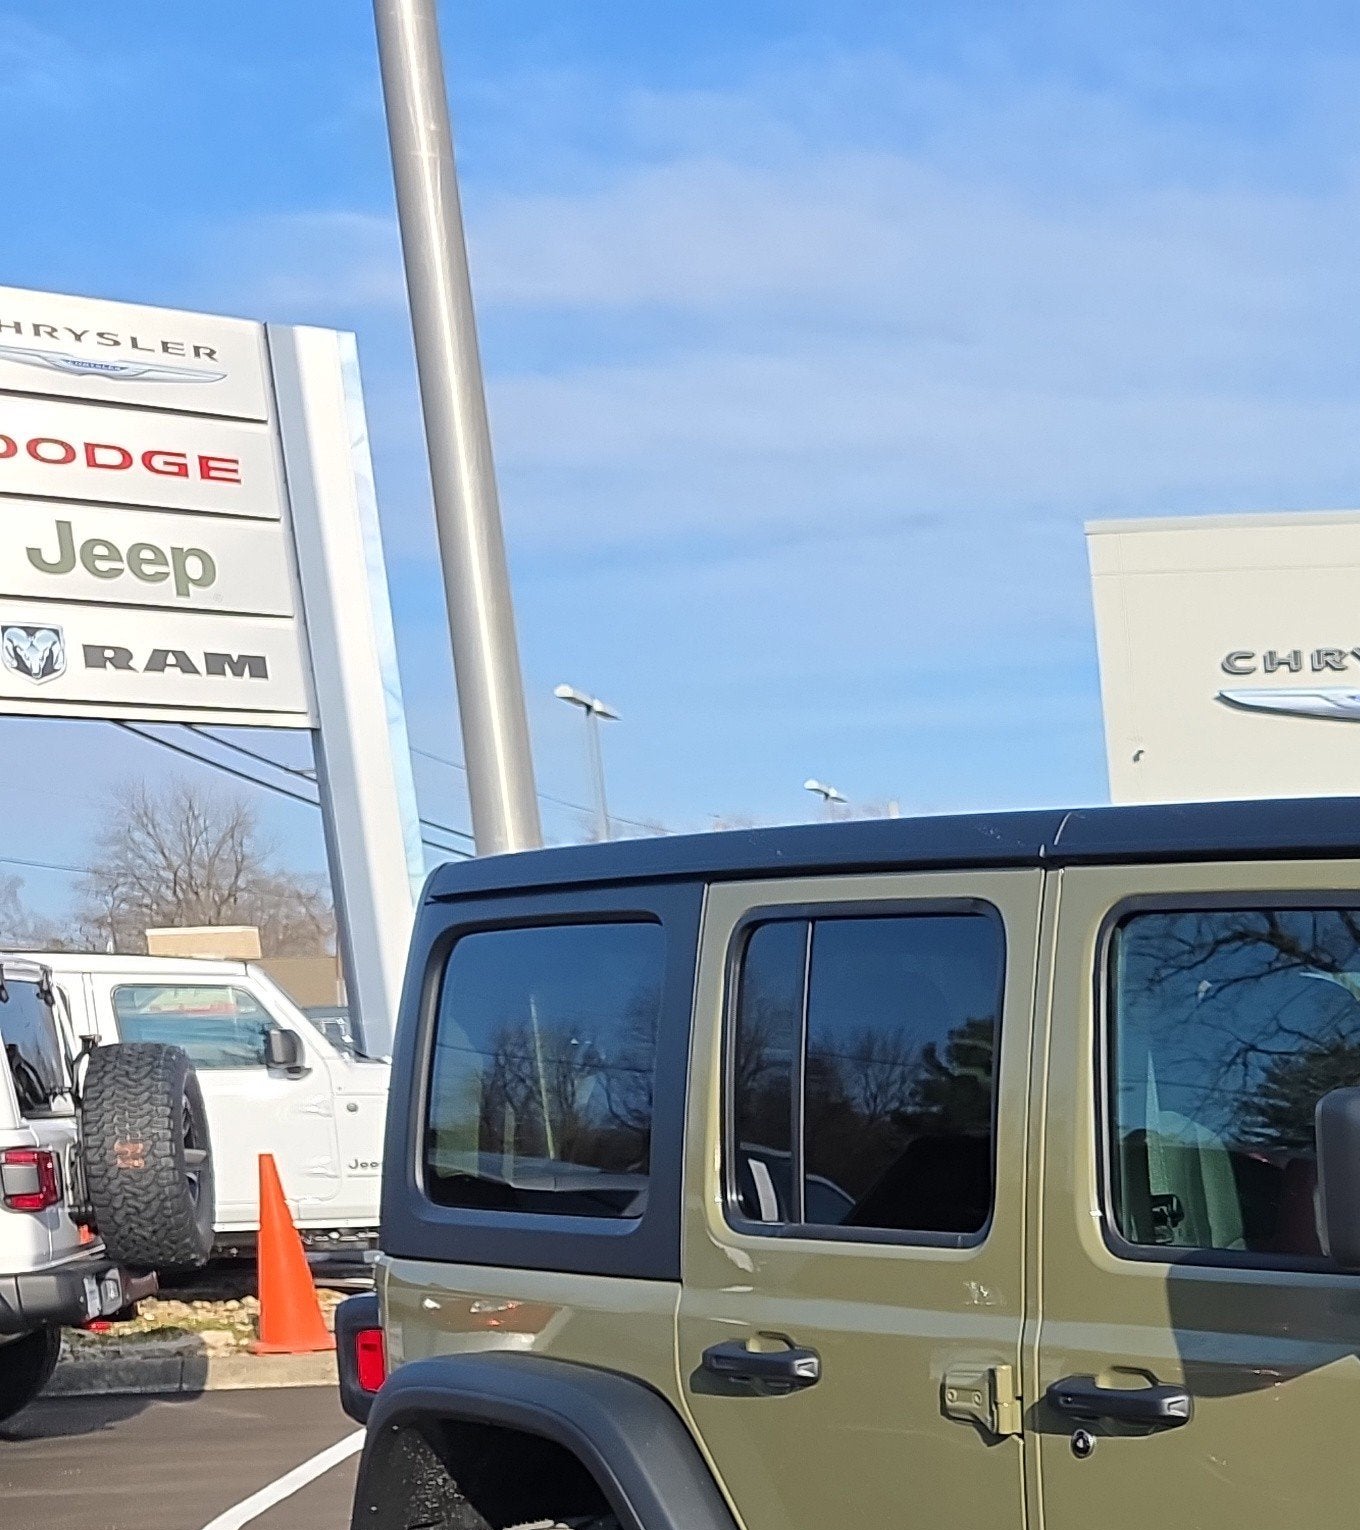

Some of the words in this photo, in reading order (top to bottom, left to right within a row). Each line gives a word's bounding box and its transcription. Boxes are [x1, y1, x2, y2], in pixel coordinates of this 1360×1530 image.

[0, 319, 219, 362] HRYSLER
[26, 520, 217, 597] Jeep
[82, 643, 270, 680] RAM
[349, 1159, 380, 1170] Jee
